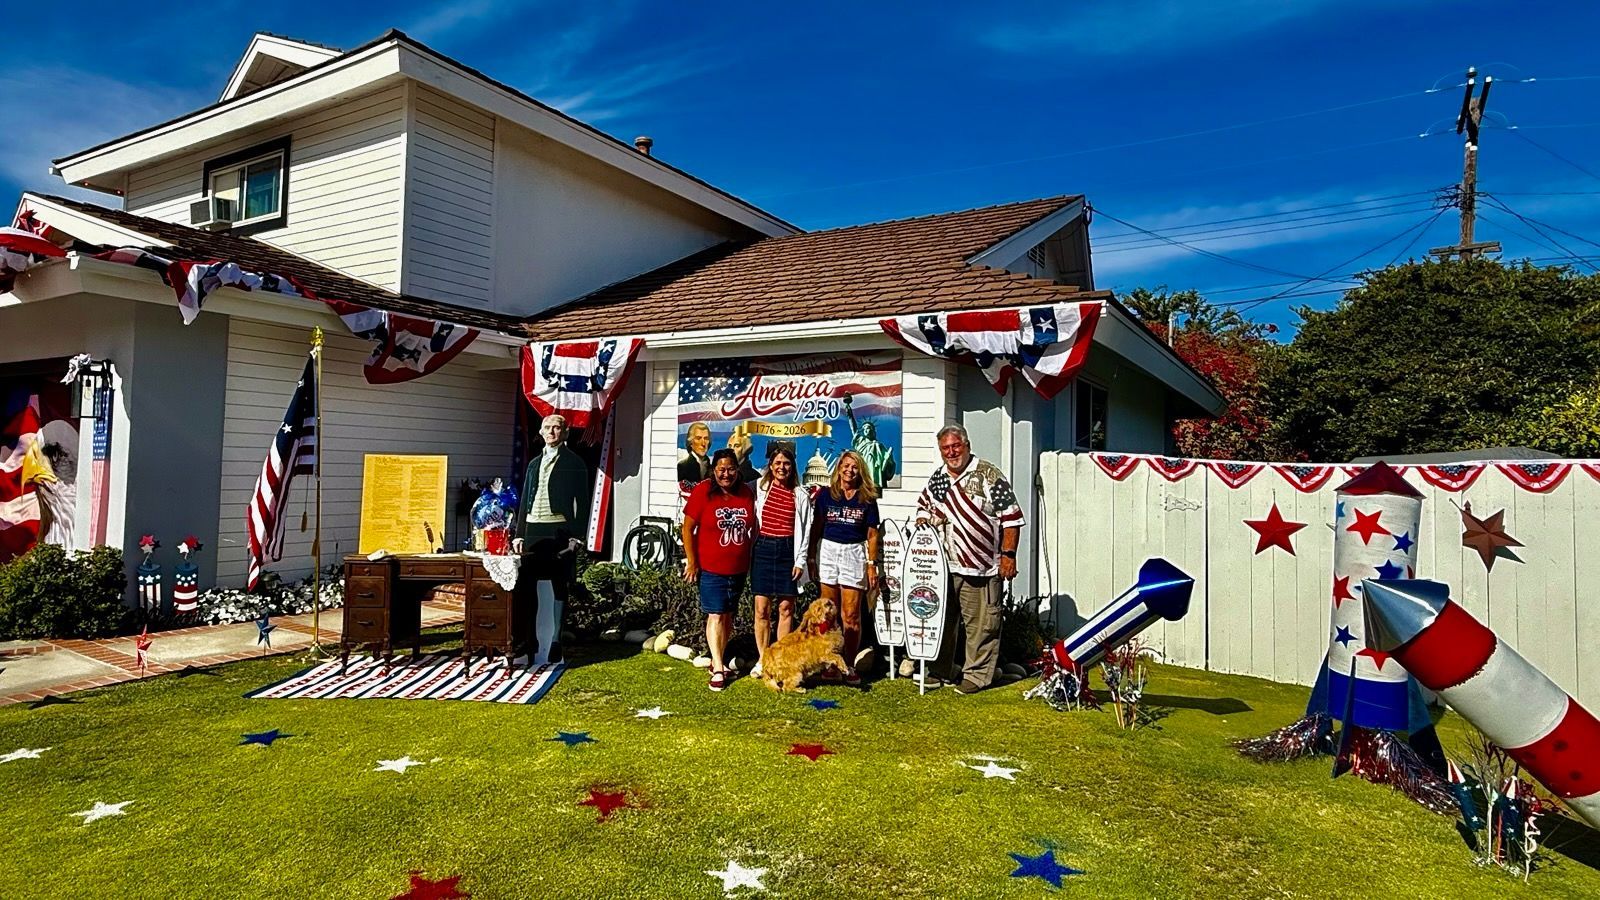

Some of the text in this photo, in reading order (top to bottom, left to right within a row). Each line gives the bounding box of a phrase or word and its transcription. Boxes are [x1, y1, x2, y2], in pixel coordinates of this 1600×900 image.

[720, 374, 835, 418] America
[793, 399, 841, 421] /250
[755, 423, 775, 435] 1776
[783, 423, 807, 436] 2026
[911, 548, 938, 556] WINNER
[912, 557, 936, 565] Citywide
[910, 567, 939, 576] Decorating
